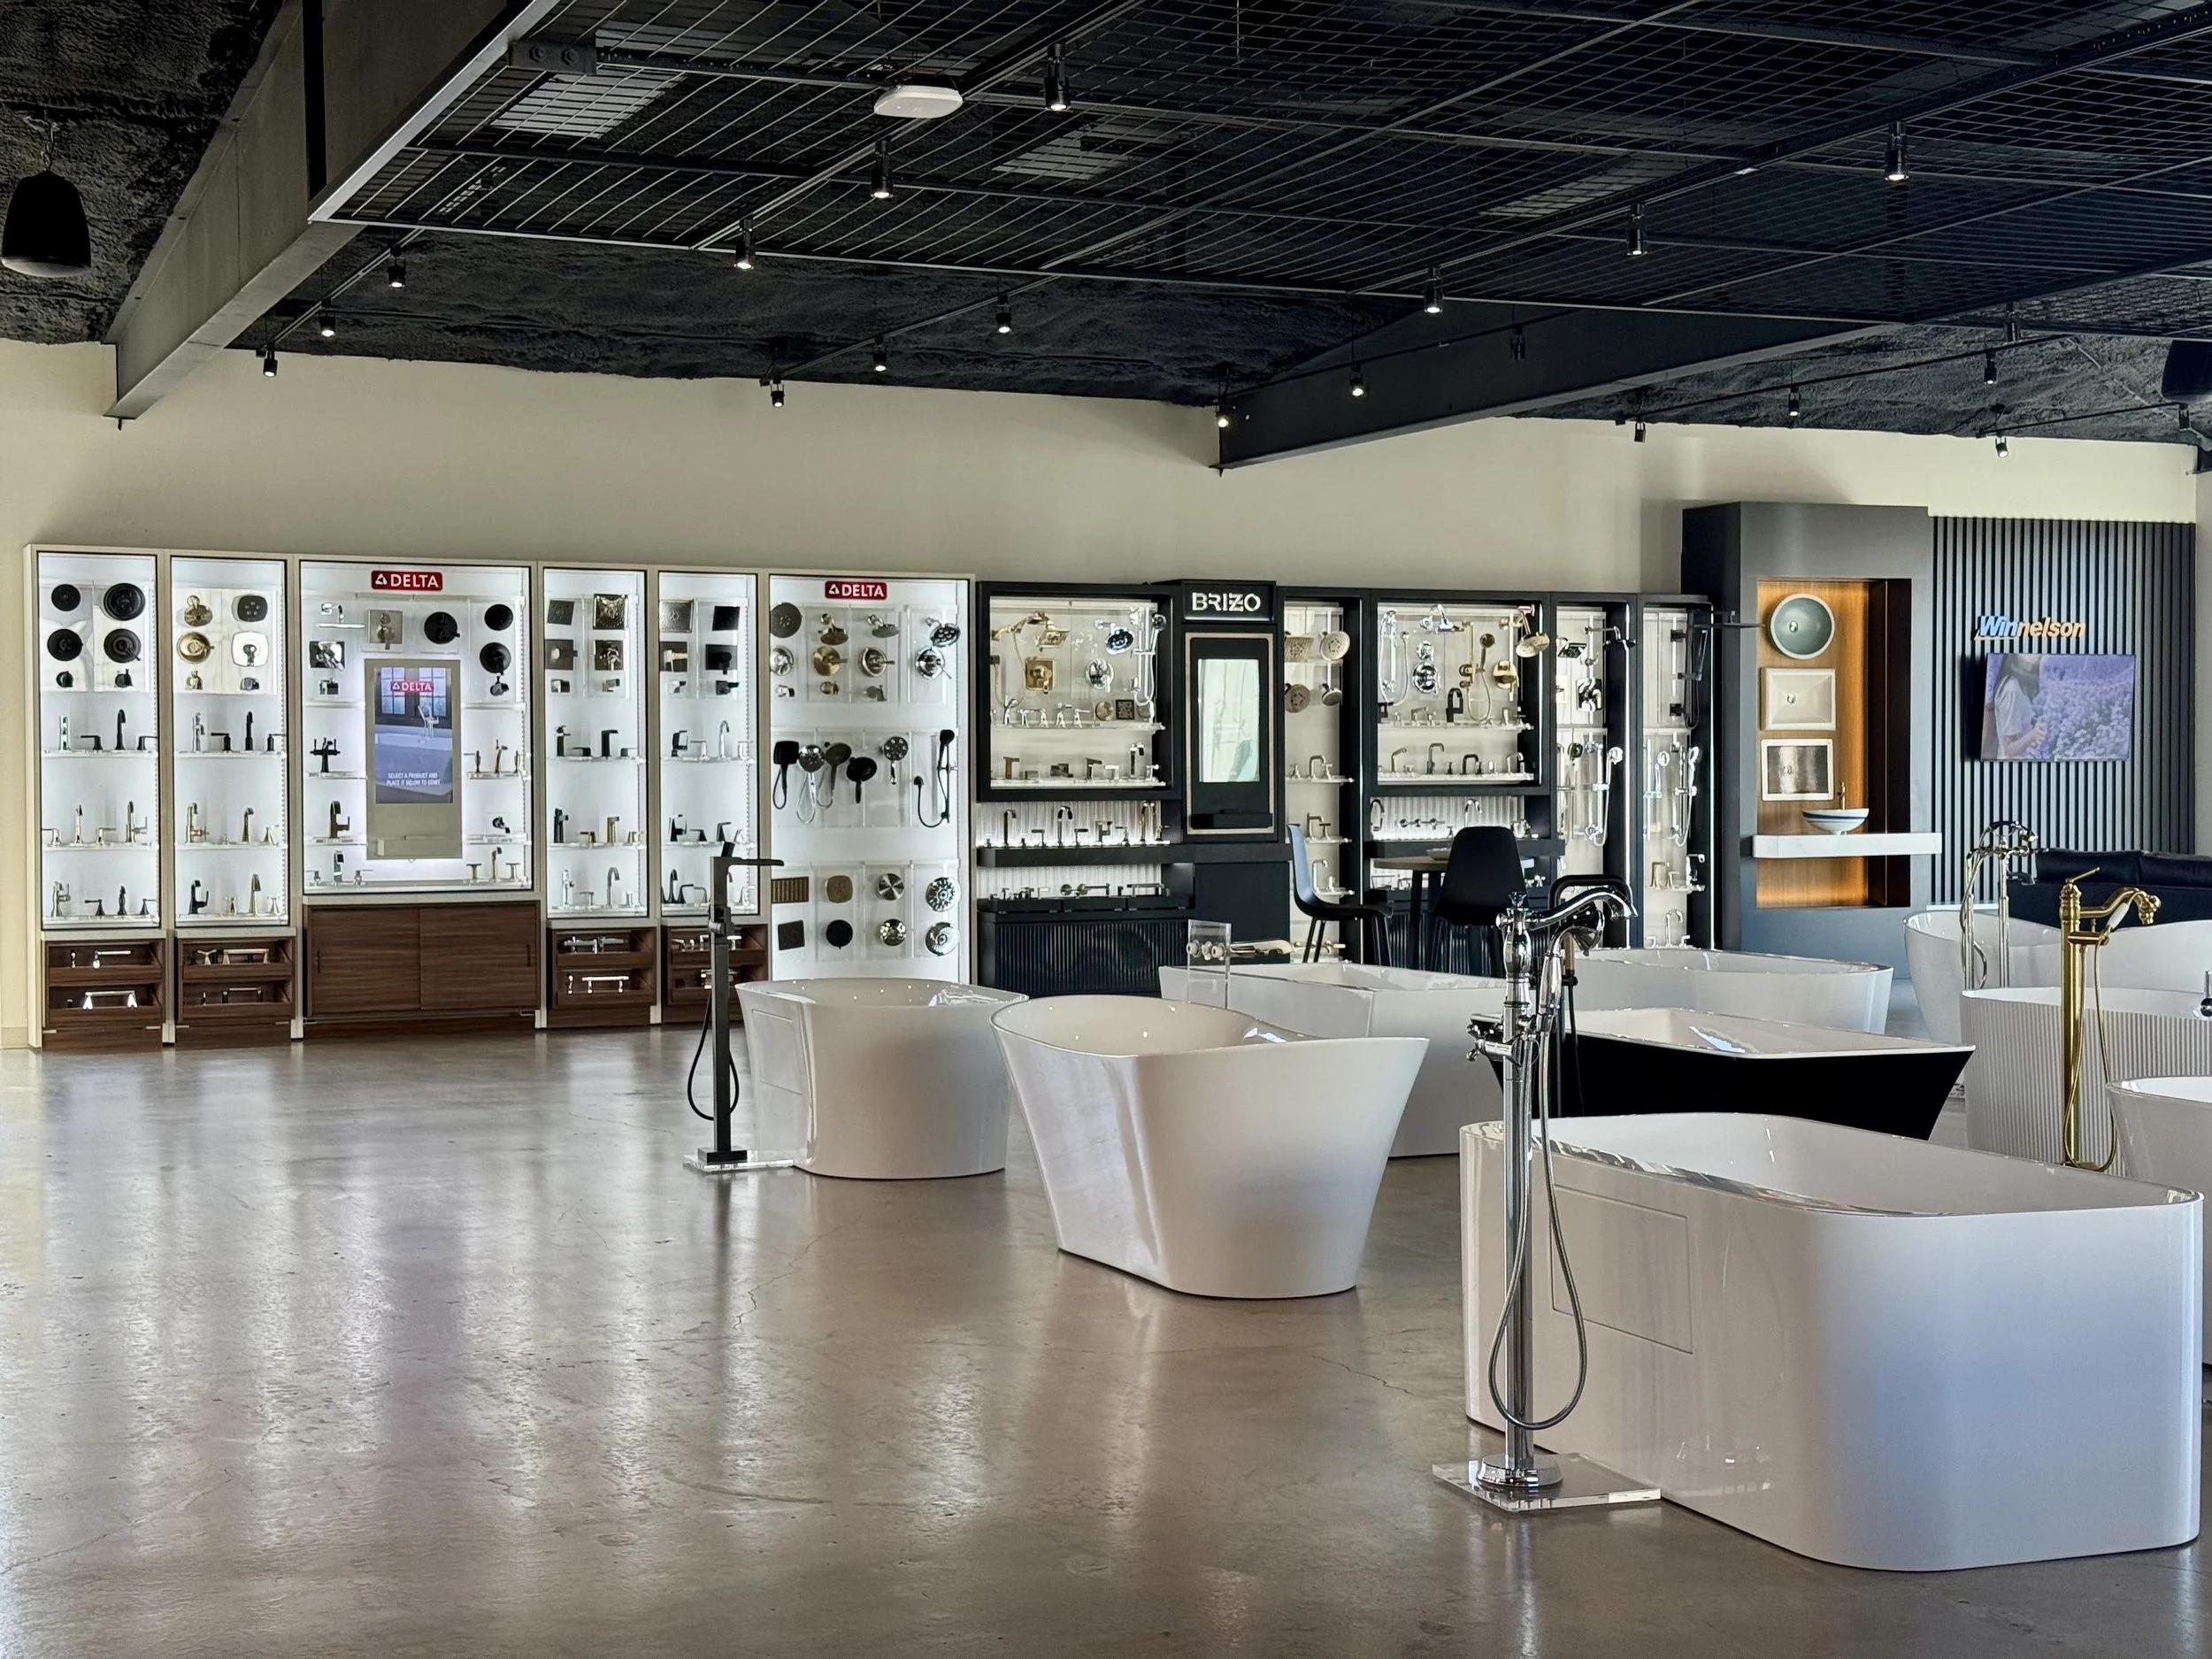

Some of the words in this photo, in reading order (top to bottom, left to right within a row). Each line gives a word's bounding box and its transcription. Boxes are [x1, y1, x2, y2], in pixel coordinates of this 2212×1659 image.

[390, 573, 439, 588] DELTA
[841, 584, 885, 597] DELTA
[1192, 592, 1262, 612] BRIZO
[1980, 615, 2085, 638] Winnelson
[402, 682, 432, 692] DELTA
